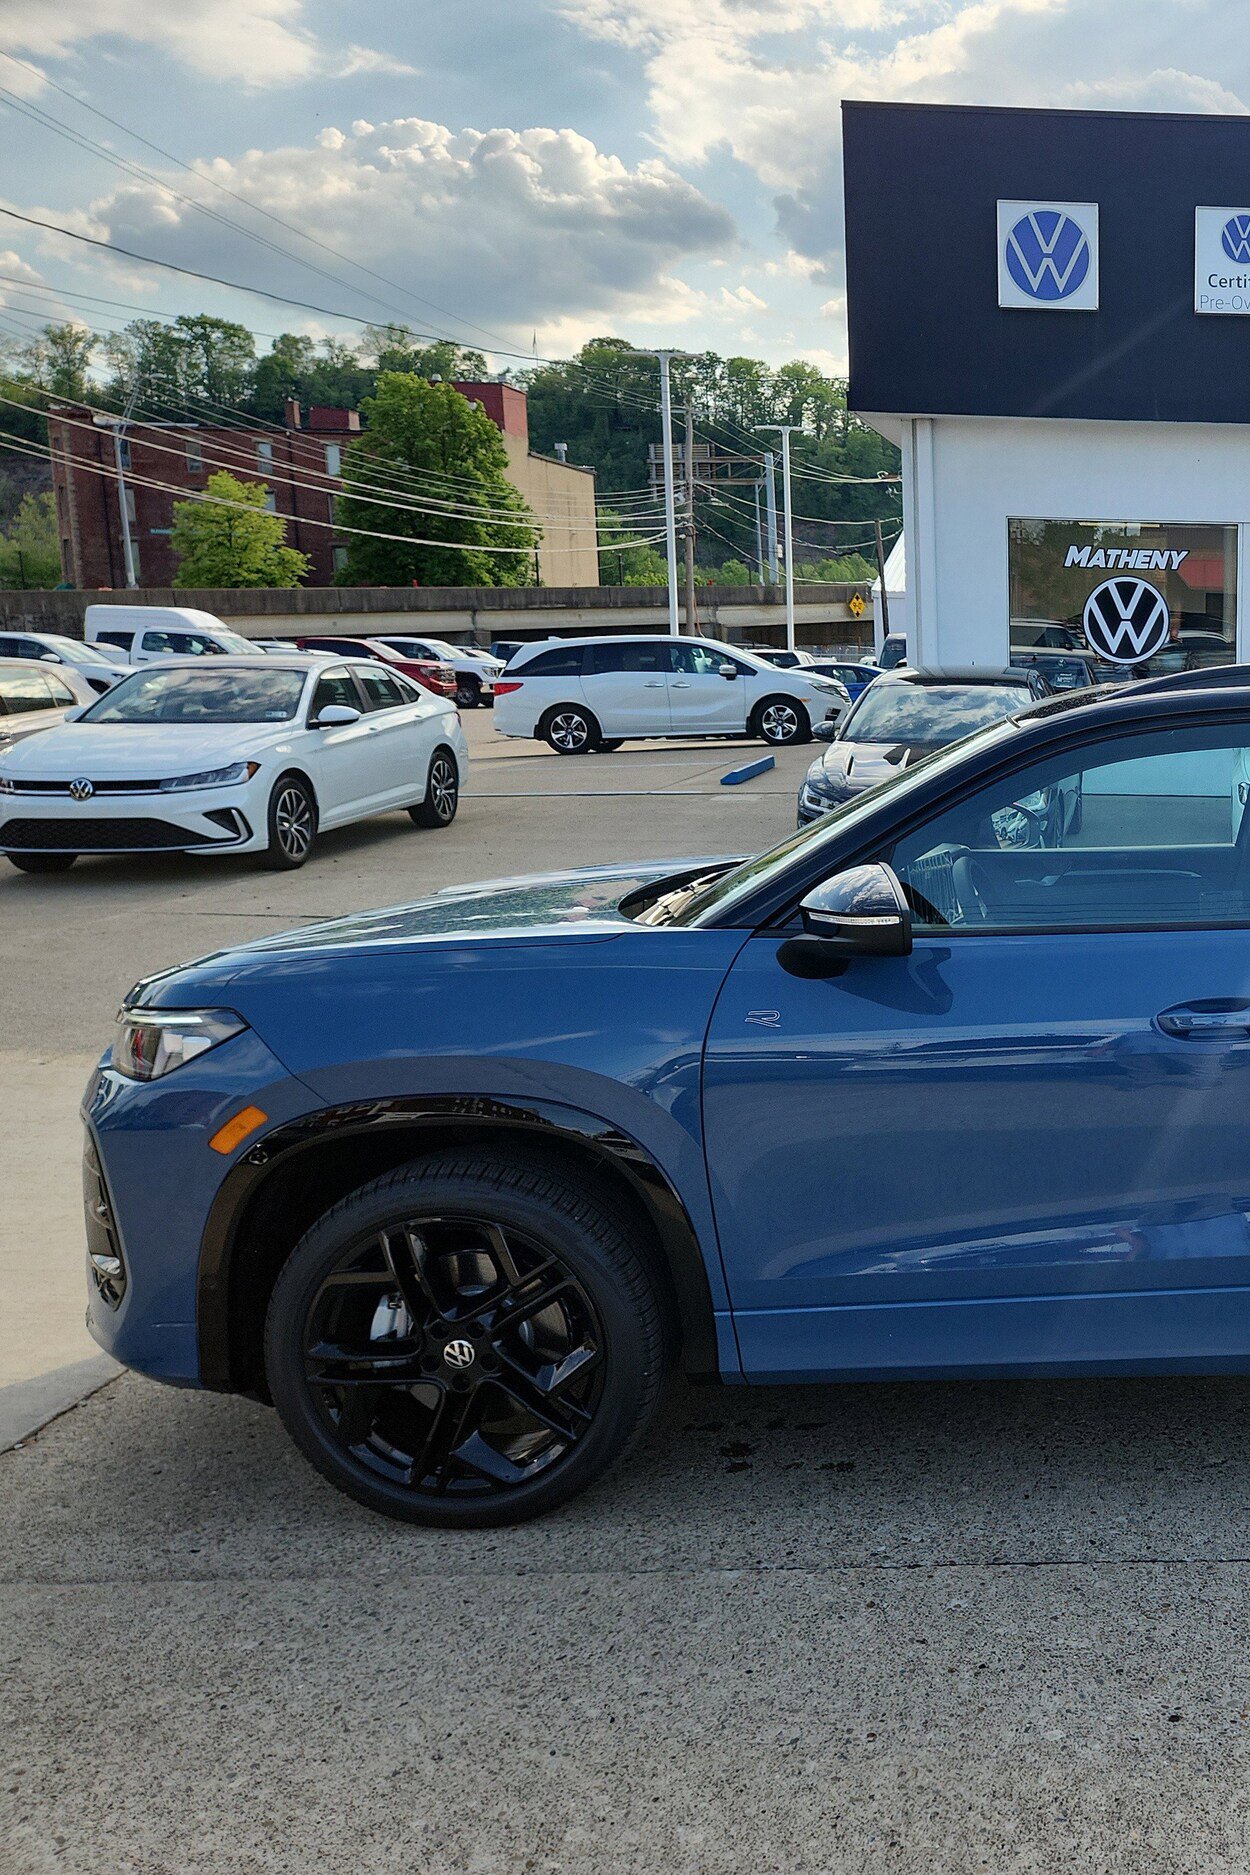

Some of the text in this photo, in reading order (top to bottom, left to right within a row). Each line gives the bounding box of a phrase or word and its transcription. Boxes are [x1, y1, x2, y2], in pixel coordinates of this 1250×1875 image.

[1005, 209, 1091, 300] VW
[1064, 545, 1188, 570] MATHENY
[1084, 577, 1169, 661] VW
[744, 1010, 782, 1028] R
